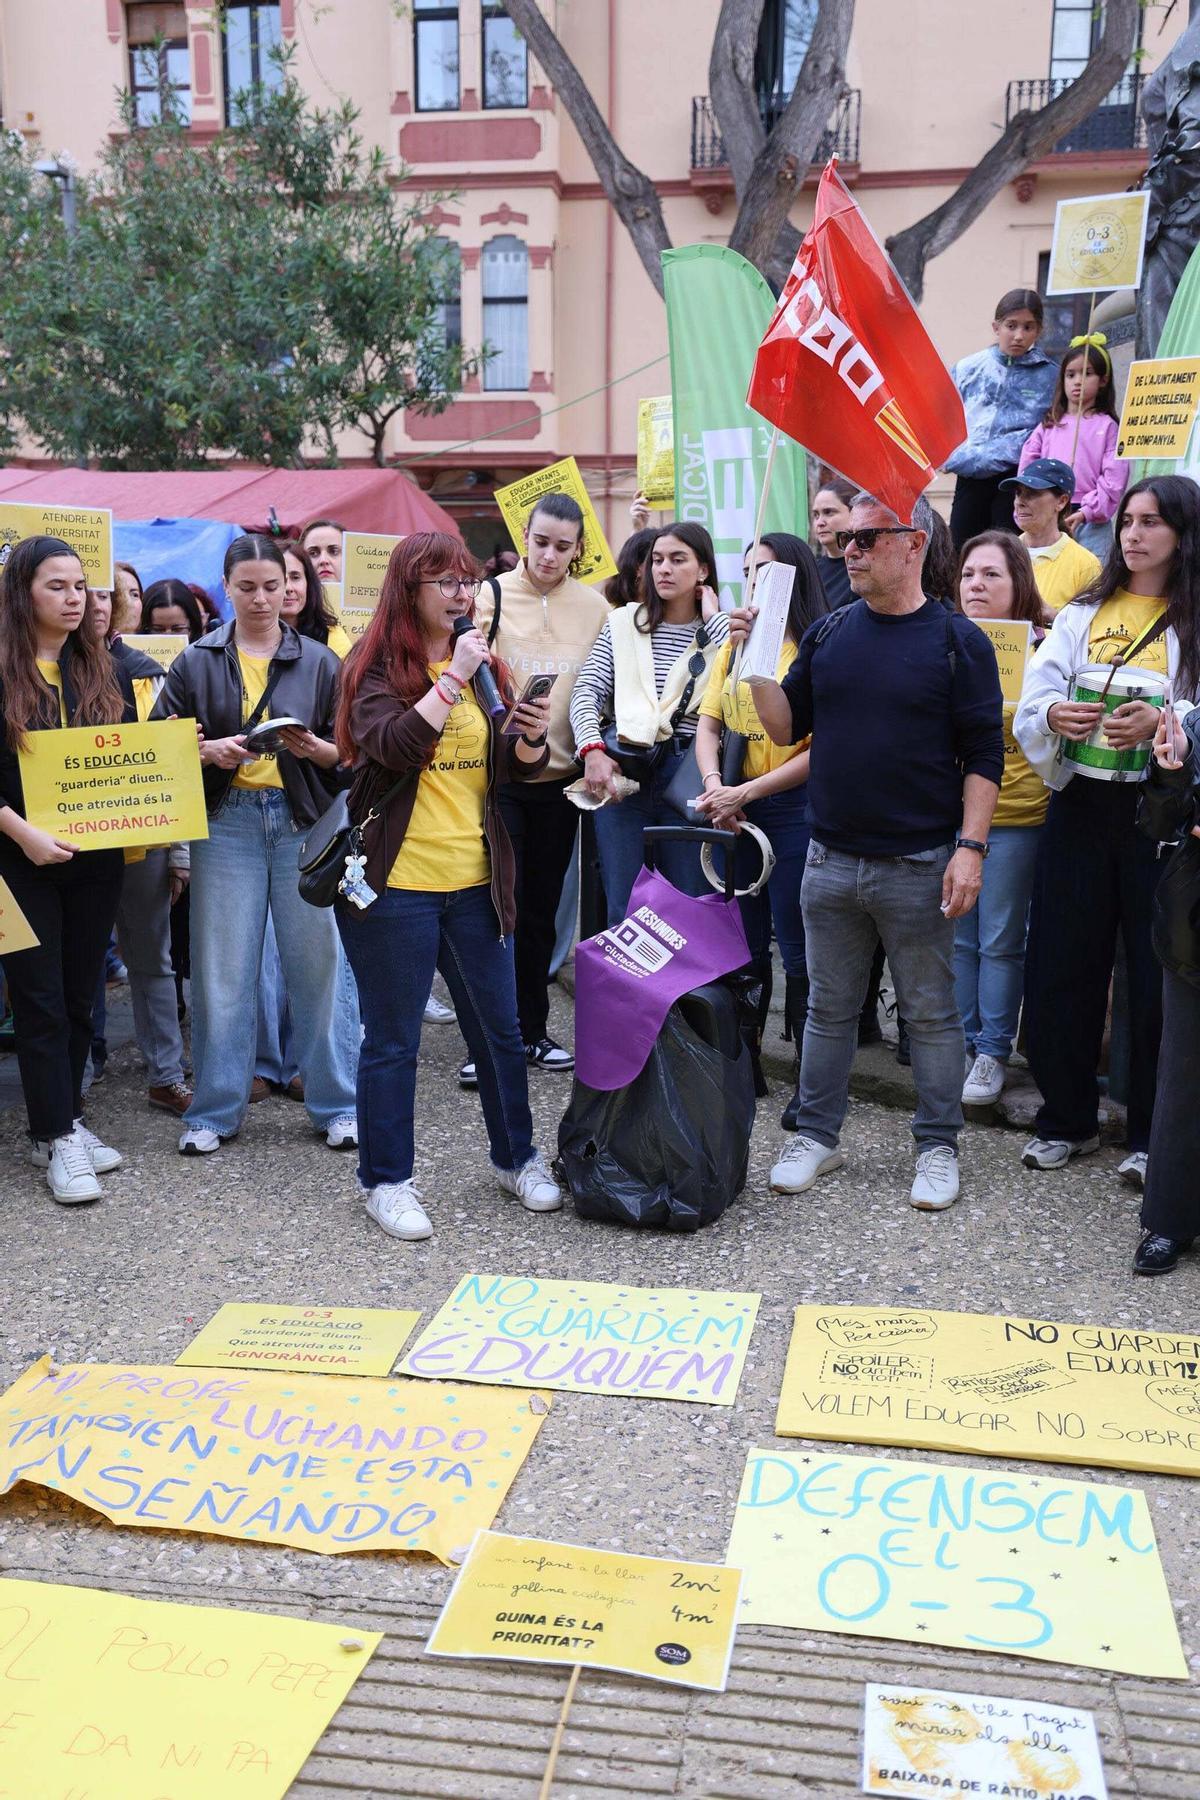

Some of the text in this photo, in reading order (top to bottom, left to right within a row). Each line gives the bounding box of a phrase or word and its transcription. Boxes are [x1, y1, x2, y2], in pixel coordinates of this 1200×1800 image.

[1087, 226, 1110, 240] 0-3
[1134, 372, 1197, 387] DE L'AJUNTAMENT
[1130, 396, 1135, 406] A
[1135, 395, 1144, 406] LA
[1126, 414, 1189, 426] AMB LA PLANTILLA
[1127, 435, 1135, 446] EN
[42, 512, 103, 525] ATENDRE LA
[45, 527, 101, 539] DIVERSITAT
[71, 544, 99, 553] EREIX
[995, 643, 1021, 654] NCIA,
[94, 733, 122, 749] 0-3
[64, 749, 156, 770] ÉS EDUCACIÓ
[458, 759, 485, 770] EDUCA
[57, 792, 172, 814] Que atrevida és la
[455, 1275, 540, 1307] NO
[281, 1318, 363, 1330] EDUCACIÓ
[499, 1305, 744, 1347] GUARDEM
[1005, 1322, 1059, 1344] NO
[228, 1338, 259, 1346] Que
[261, 1340, 324, 1350] atrevida
[408, 1333, 735, 1396] EDUQUEM
[832, 1363, 922, 1379] NO arribem
[1066, 1351, 1198, 1379] EDUQUEM!
[99, 1373, 250, 1400] PROFE
[802, 1392, 891, 1417] VOLEM
[905, 1404, 1016, 1431] EDUCAR
[1038, 1411, 1085, 1439] NO
[211, 1400, 488, 1453] LUCHANDO
[248, 1452, 329, 1478] ME
[522, 1556, 574, 1572] infant
[511, 1582, 568, 1598] gallina
[495, 1612, 604, 1632] QUINA ÉS LA
[492, 1630, 595, 1649] PRIORITAT?
[660, 1646, 687, 1658] SOM
[97, 1626, 230, 1680] POLLO
[248, 1652, 346, 1699] PEPE
[933, 1703, 966, 1712] no
[1023, 1711, 1086, 1733] pogut
[896, 1720, 966, 1737] mirar
[1022, 1731, 1072, 1754] ulls
[63, 1725, 131, 1757] DA
[226, 1740, 273, 1774] PA
[878, 1769, 952, 1787] BAIXADA
[960, 1779, 981, 1792] DE
[988, 1781, 1038, 1799] RÀTIO
